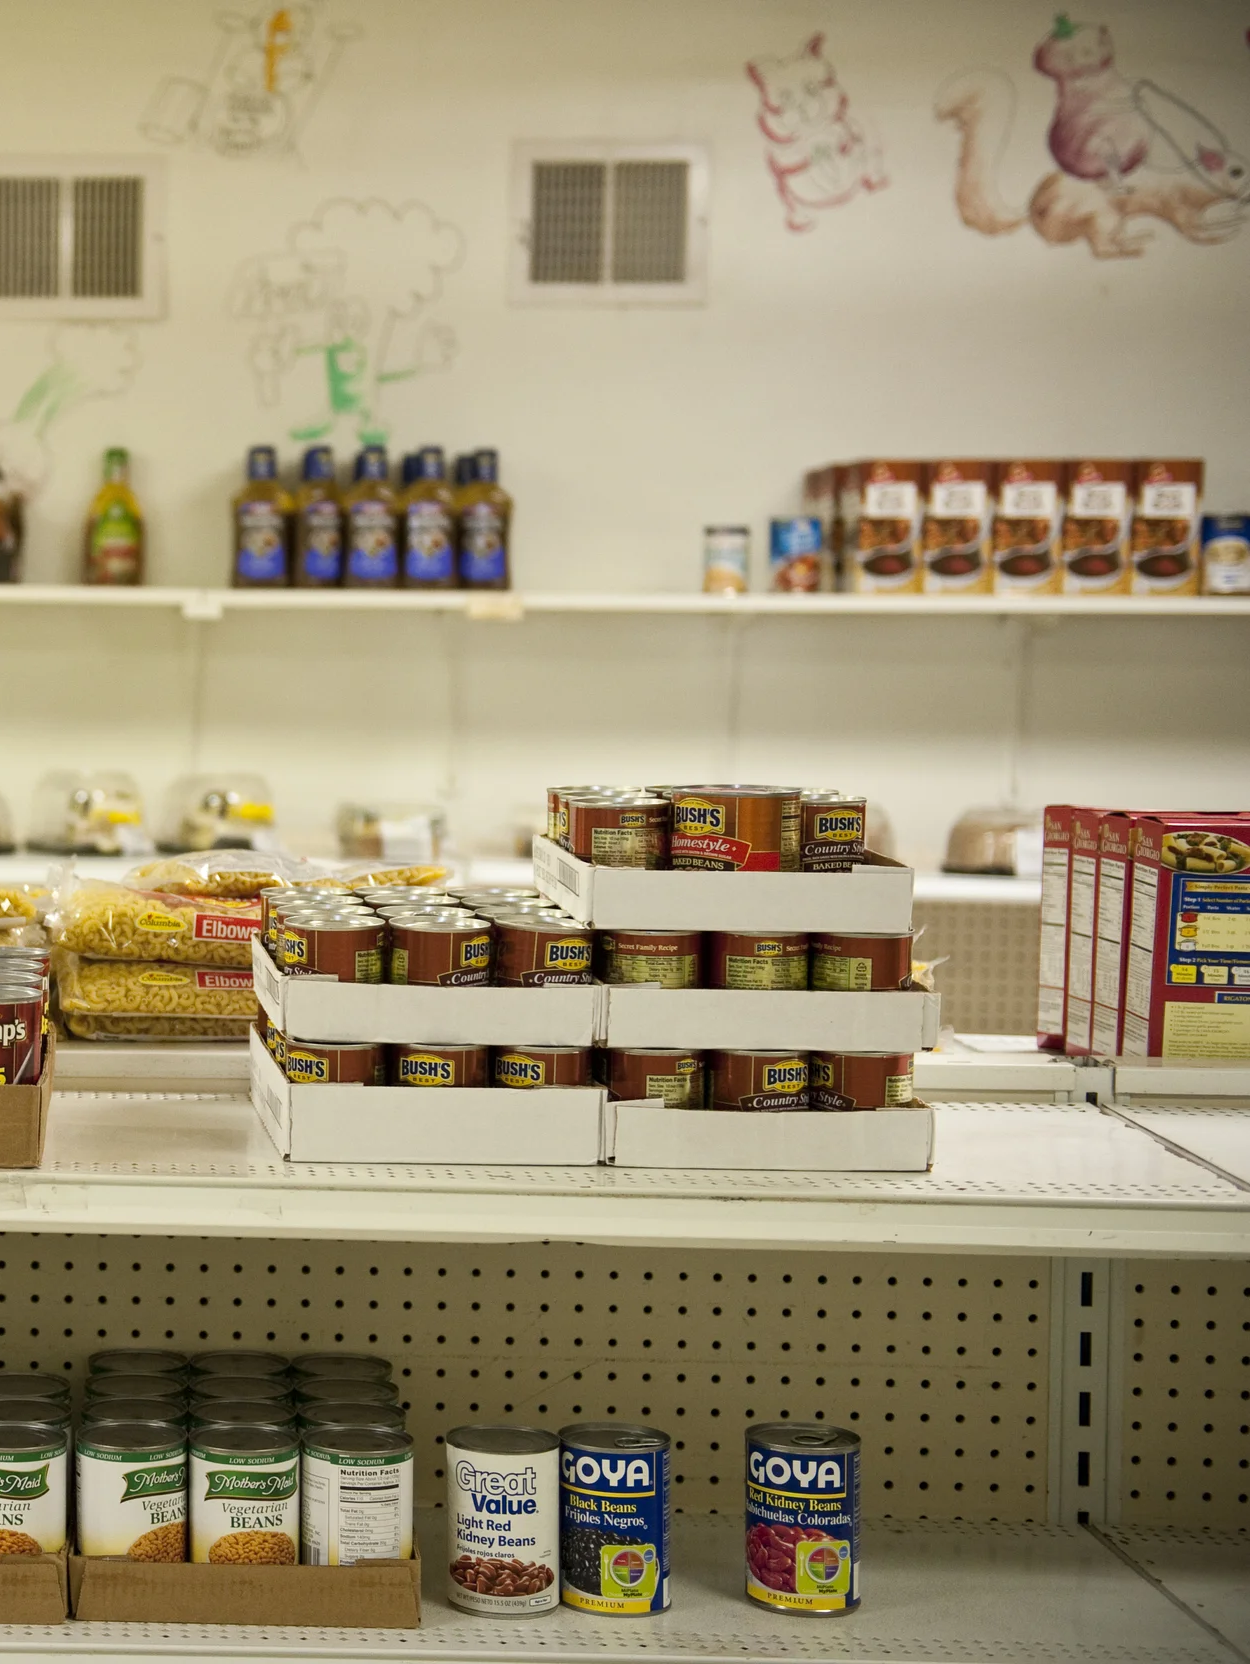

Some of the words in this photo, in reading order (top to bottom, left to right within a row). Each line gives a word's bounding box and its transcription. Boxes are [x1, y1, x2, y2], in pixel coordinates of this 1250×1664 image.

[621, 815, 645, 824] BUSH'S
[676, 806, 720, 827] BUSH'S
[819, 816, 861, 833] BUSH'S
[672, 837, 730, 852] Homestyle
[805, 843, 850, 854] Country
[692, 859, 724, 870] BEANS
[813, 862, 841, 870] BAKED
[139, 917, 181, 929] Columbia
[550, 945, 591, 961] BUSH'S
[636, 944, 656, 952] Family
[756, 944, 781, 952] BUSH'S
[451, 972, 486, 984] Country
[534, 973, 579, 984] Country
[288, 1056, 325, 1077] BUSH'S
[401, 1058, 450, 1079] BUSH'S
[497, 1059, 541, 1081] BUSH'S
[678, 1060, 696, 1070] BUSH'S
[768, 1065, 808, 1085] BUSH'S
[752, 1096, 797, 1108] Country
[97, 1453, 122, 1461] SODIUM
[310, 1451, 330, 1460] SODIUM
[340, 1469, 378, 1477] Nutrition
[562, 1451, 649, 1487] GOYA
[750, 1451, 840, 1488] GOYA
[0, 1474, 41, 1493] Maid
[130, 1471, 179, 1492] Mother's
[211, 1474, 266, 1492] Mother's
[262, 1473, 294, 1495] Maid
[455, 1460, 537, 1496] Great
[222, 1501, 288, 1515] Vegetarian
[471, 1493, 536, 1515] Value
[569, 1494, 597, 1511] Black
[601, 1500, 636, 1513] Beans
[750, 1488, 763, 1502] Red
[766, 1494, 806, 1514] Kidney
[809, 1500, 841, 1511] Beans
[230, 1514, 283, 1529] BEANS
[456, 1513, 483, 1530] Light
[486, 1520, 511, 1532] Red
[564, 1506, 600, 1524] Frijoles
[603, 1514, 644, 1530] Negros
[798, 1513, 851, 1526] Coloradas
[456, 1528, 495, 1549] Kidney
[498, 1535, 536, 1547] Beans
[456, 1544, 476, 1556] Frijoles
[477, 1550, 493, 1558] rojos
[580, 1597, 625, 1609] PREMIUM
[767, 1592, 813, 1605] PREMIUM
